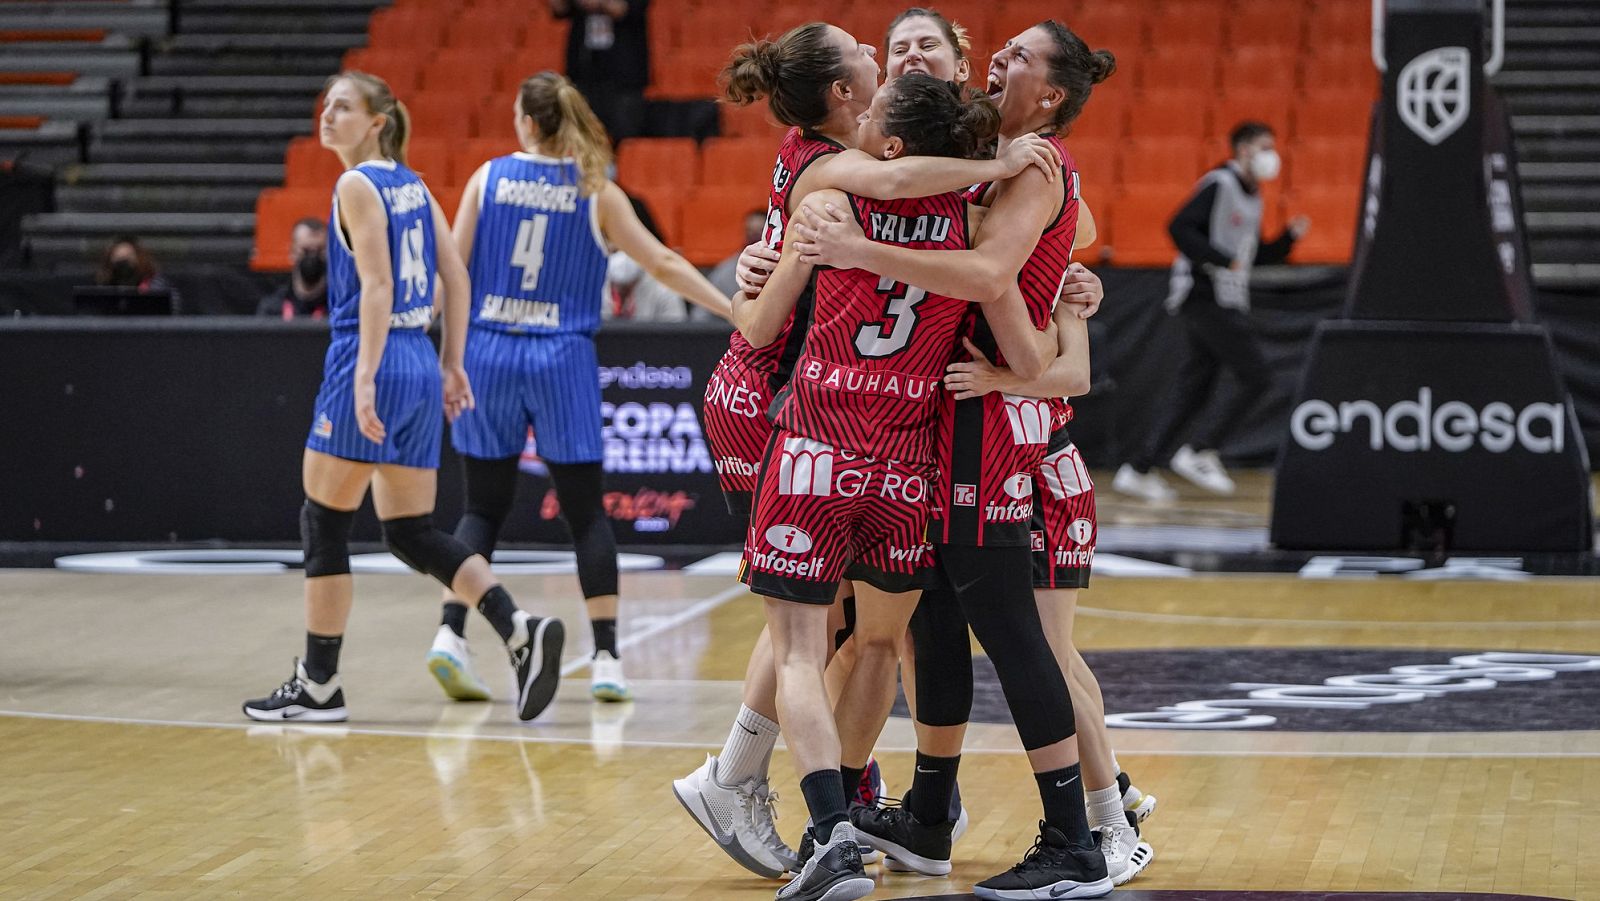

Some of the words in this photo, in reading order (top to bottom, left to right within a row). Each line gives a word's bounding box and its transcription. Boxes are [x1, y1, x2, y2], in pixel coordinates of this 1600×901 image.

[496, 176, 578, 213] RODRÍGUEZ
[511, 214, 548, 291] 4
[871, 213, 951, 242] PALAU
[854, 273, 927, 357] 3
[1290, 386, 1565, 453] endesa
[753, 547, 824, 578] infoself
